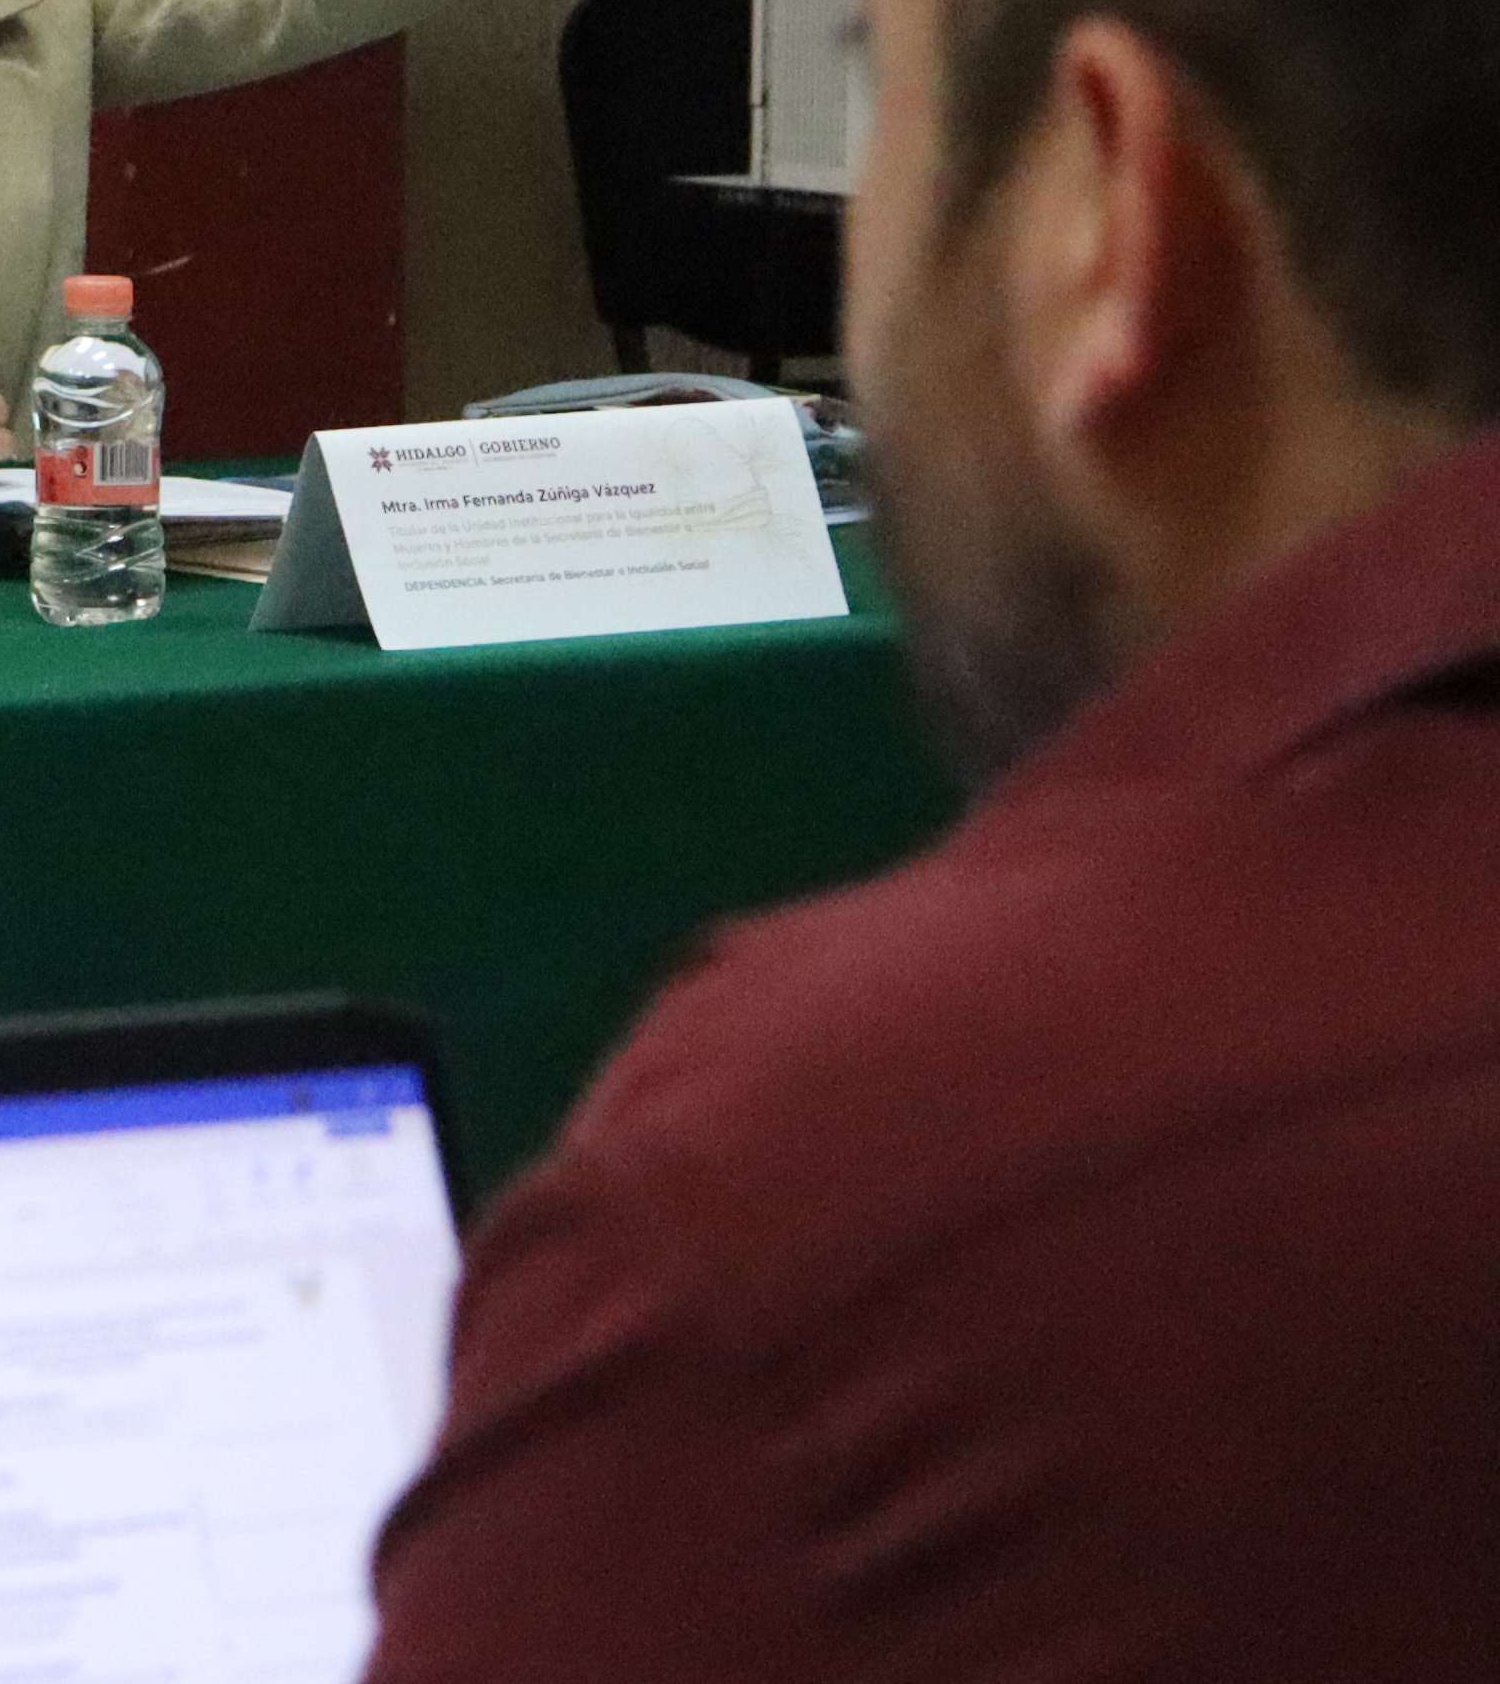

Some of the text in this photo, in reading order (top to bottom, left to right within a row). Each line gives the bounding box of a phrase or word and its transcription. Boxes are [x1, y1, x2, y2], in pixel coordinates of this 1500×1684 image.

[394, 445, 467, 461] HIDALGO
[478, 437, 561, 454] GOBIERNO
[381, 498, 422, 515] Mtra.
[424, 497, 460, 512] Irma
[462, 489, 534, 509] Fernanda
